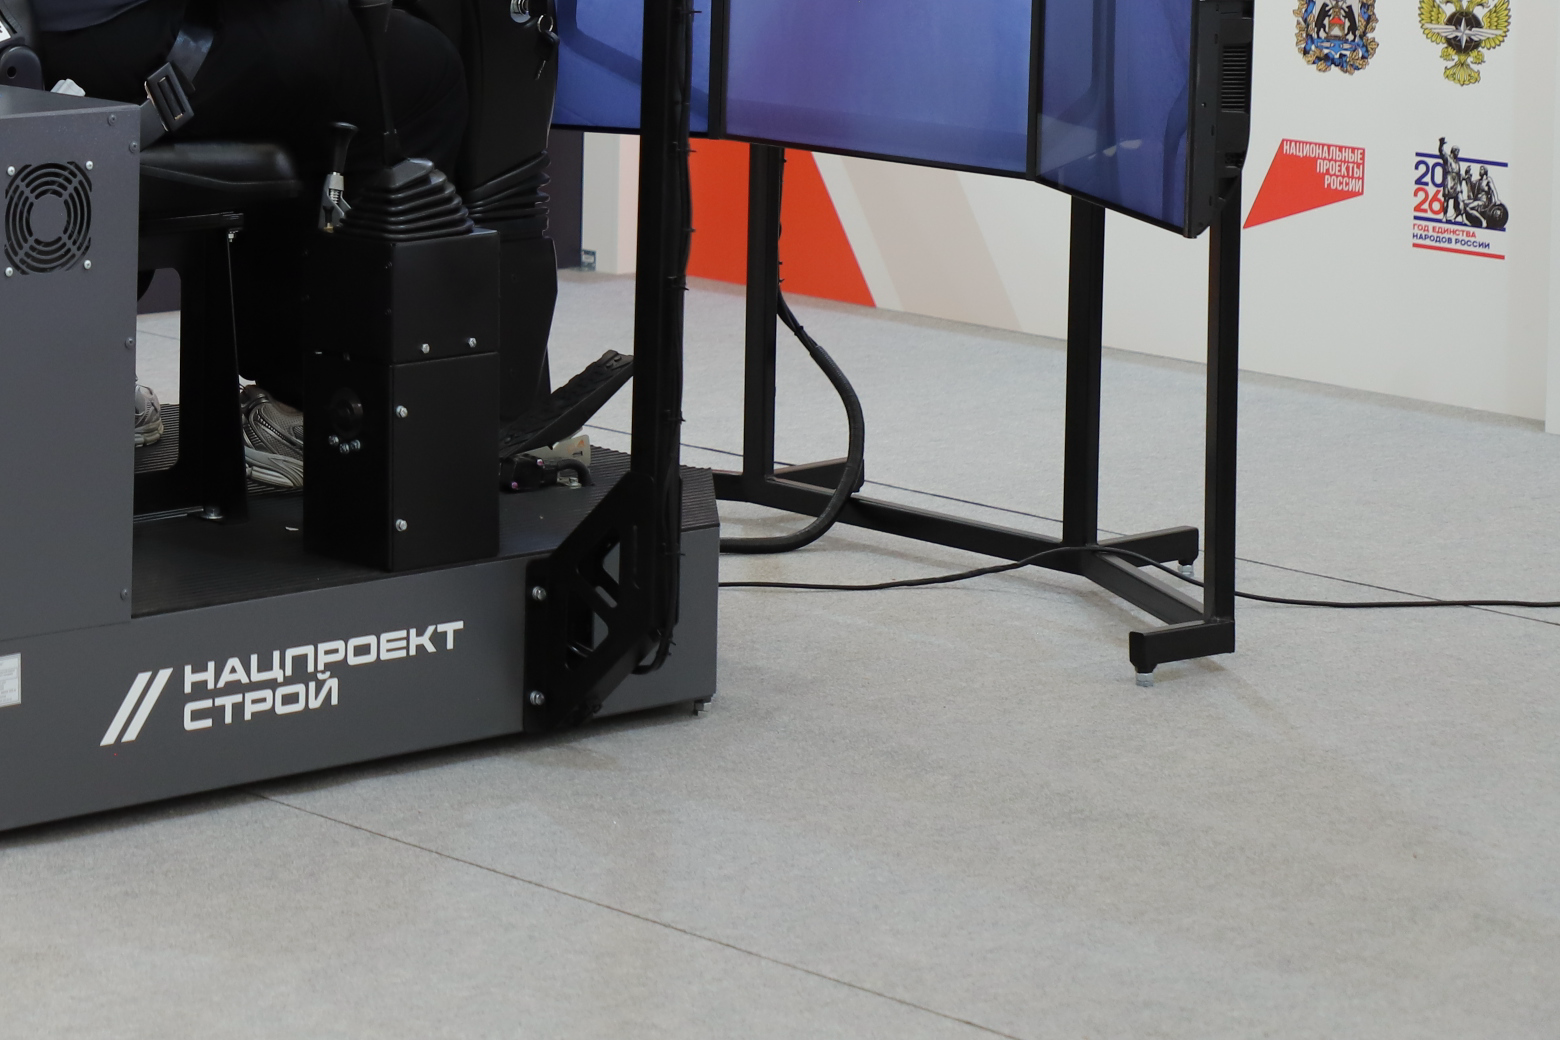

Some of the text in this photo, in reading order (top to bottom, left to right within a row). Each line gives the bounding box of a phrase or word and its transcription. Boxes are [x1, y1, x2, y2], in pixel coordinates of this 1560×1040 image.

[1283, 140, 1364, 163] НАЦИОНАЛЬНЫЕ
[1316, 159, 1363, 177] ПРОЕКТЫ
[1414, 159, 1445, 188] 20
[1324, 175, 1363, 193] РОССИИ
[1413, 186, 1445, 215] 26
[1412, 223, 1476, 238] ГОД ЕДИНСТВА
[1412, 233, 1491, 249] НАРОДОВ РОССИИ
[183, 620, 464, 694] НАЦПРОЕКТ
[183, 672, 339, 732] СТРОЙ
